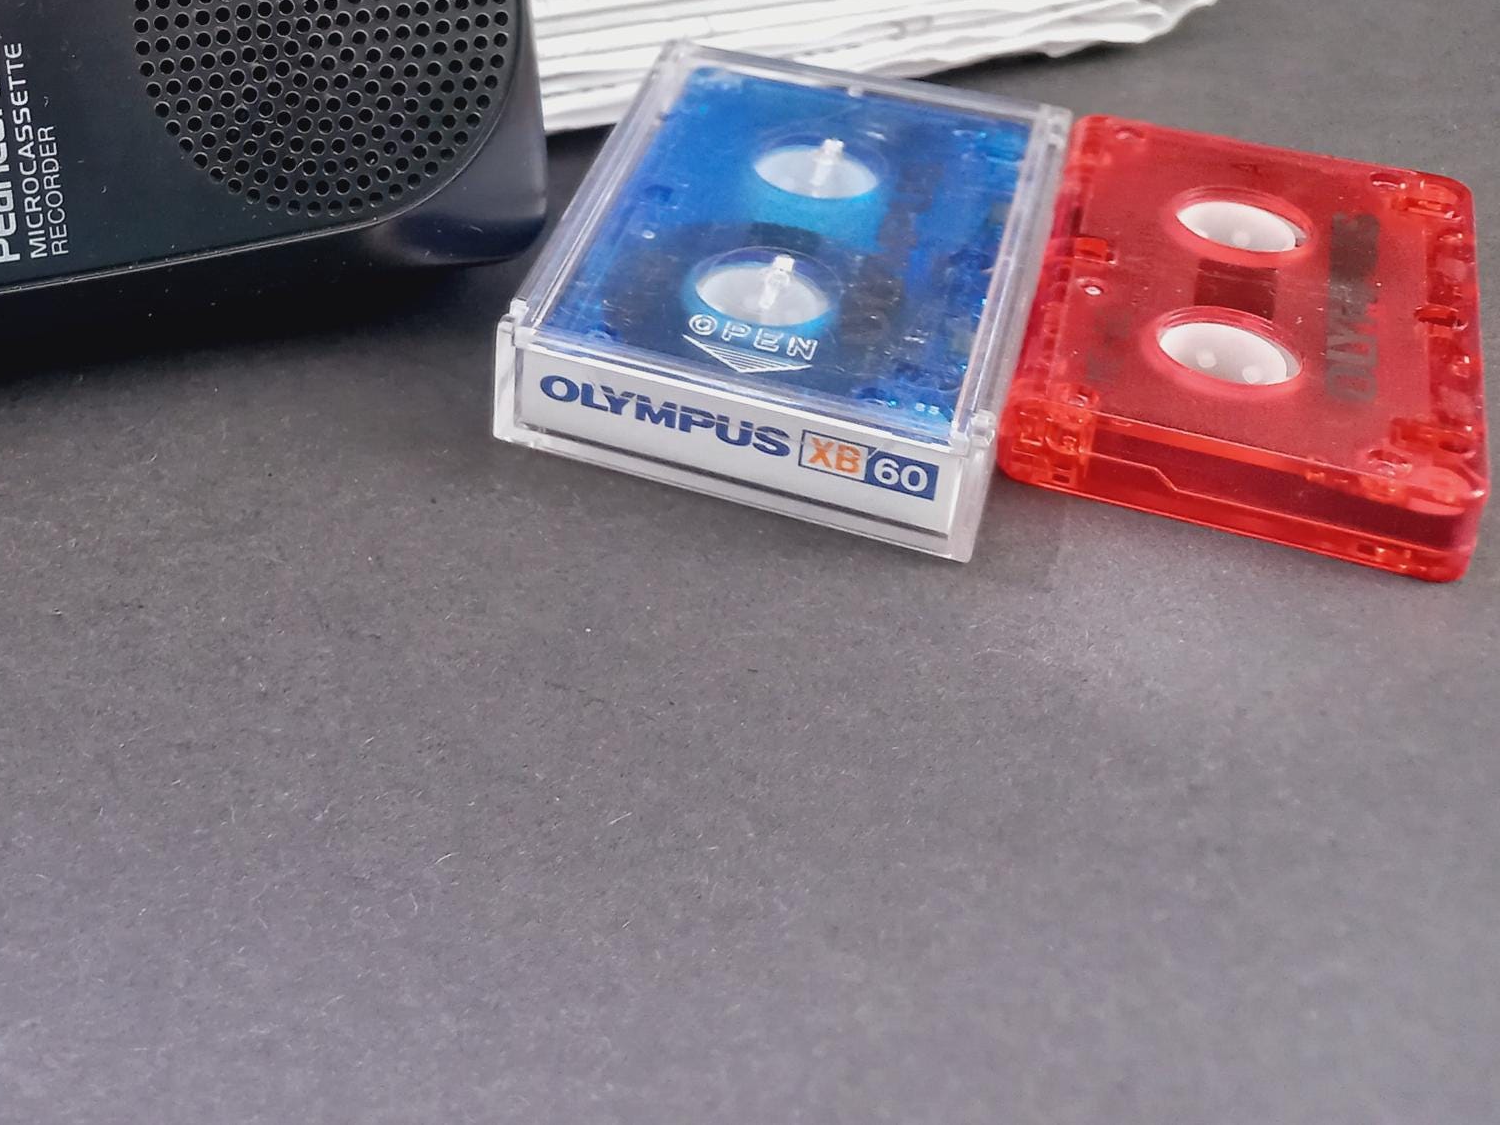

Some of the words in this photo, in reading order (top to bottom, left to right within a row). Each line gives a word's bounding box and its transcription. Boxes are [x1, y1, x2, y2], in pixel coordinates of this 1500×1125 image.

[4, 42, 48, 259] MICROCASSETTE
[38, 125, 69, 256] RECORDER
[688, 314, 818, 361] OPEN
[540, 375, 792, 458] OLYMPUS
[806, 435, 862, 475] XB
[873, 458, 928, 493] 60
